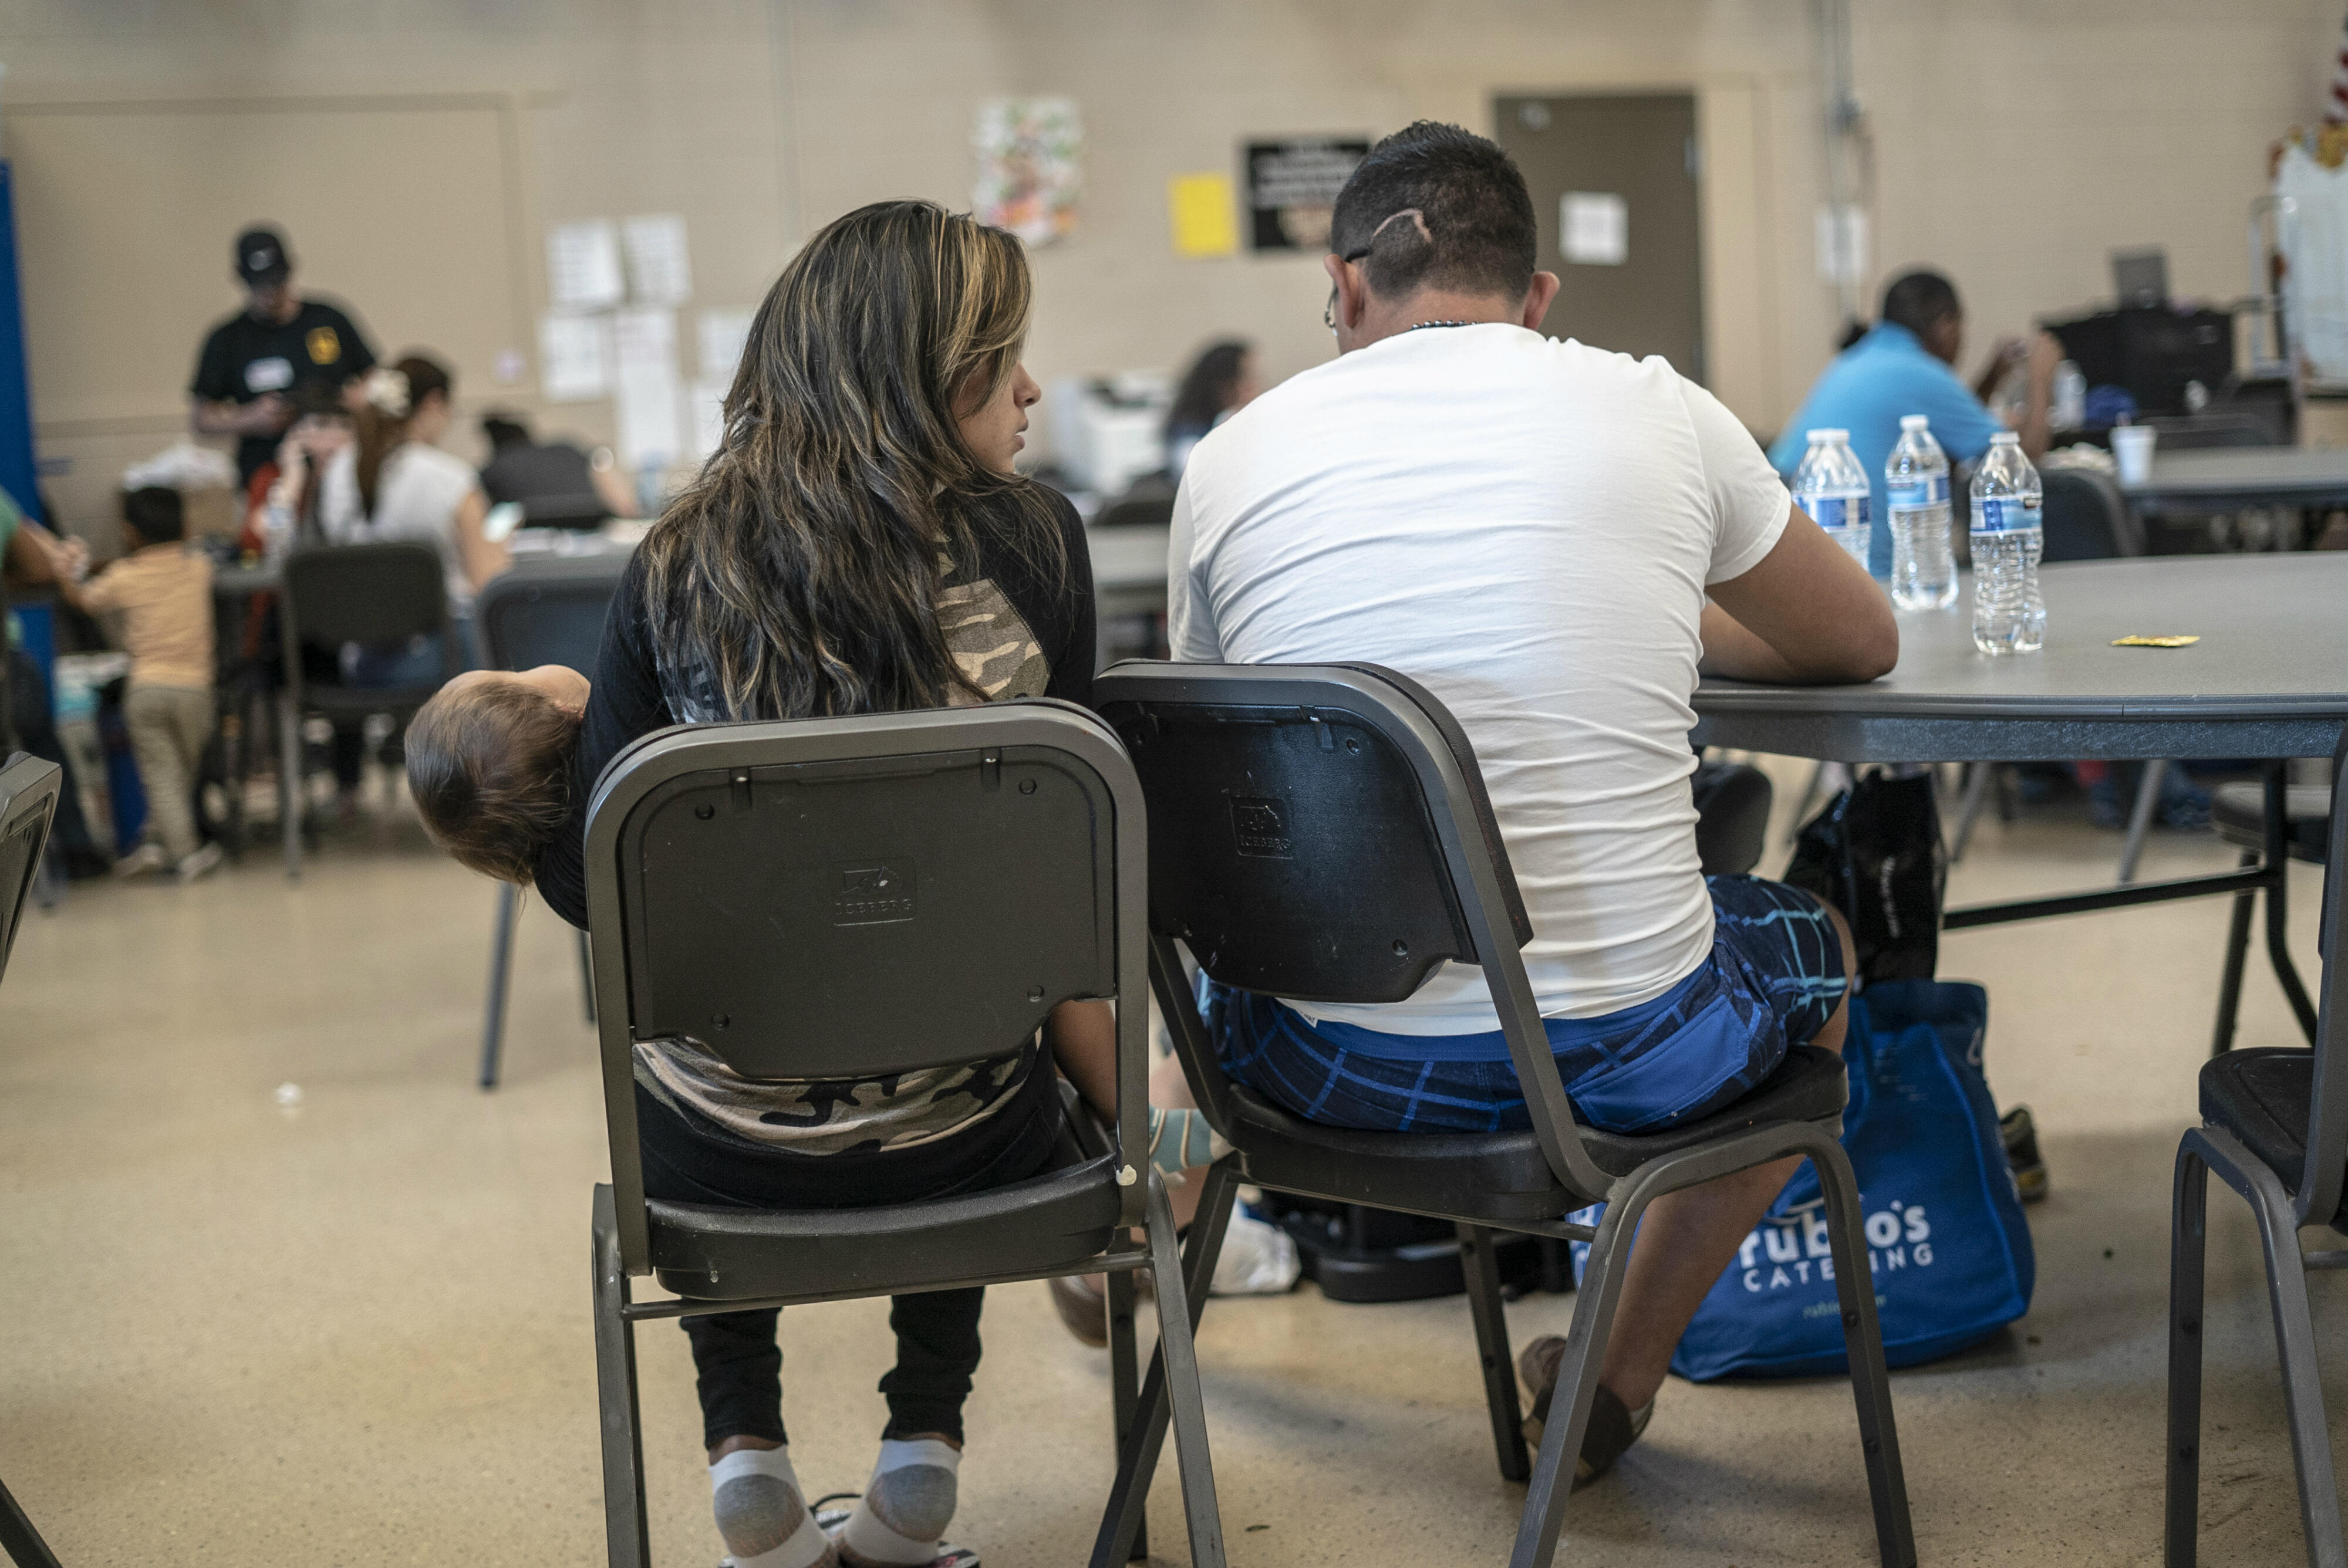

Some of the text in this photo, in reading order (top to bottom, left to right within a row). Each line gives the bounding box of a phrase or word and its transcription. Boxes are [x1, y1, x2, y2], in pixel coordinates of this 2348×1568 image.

[836, 898, 912, 915] ICEBERG
[1739, 1199, 1931, 1269] rubo's
[1743, 1242, 1934, 1292] CATEING
